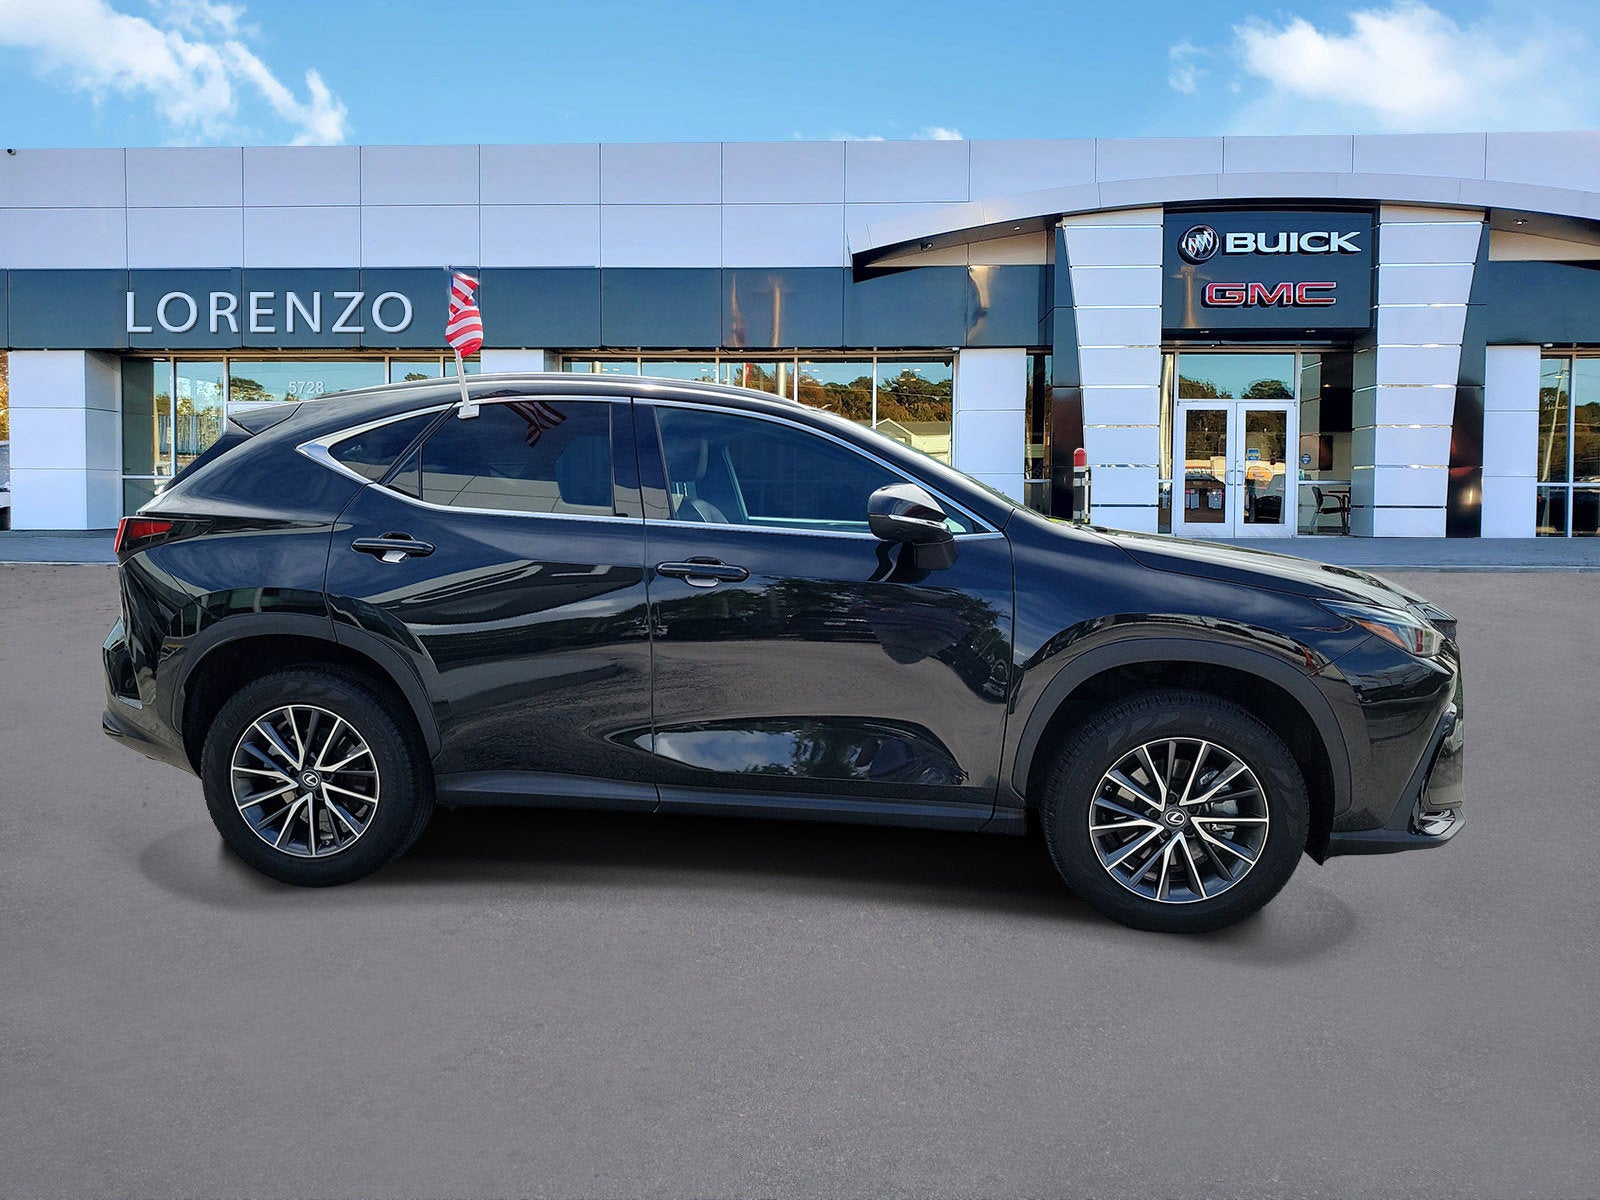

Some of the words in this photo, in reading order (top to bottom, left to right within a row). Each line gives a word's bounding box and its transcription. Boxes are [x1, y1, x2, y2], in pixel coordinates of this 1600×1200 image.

[1225, 231, 1362, 253] BUICK
[1205, 281, 1337, 306] GMC
[126, 291, 413, 333] LORENZO
[288, 380, 325, 395] 5728
